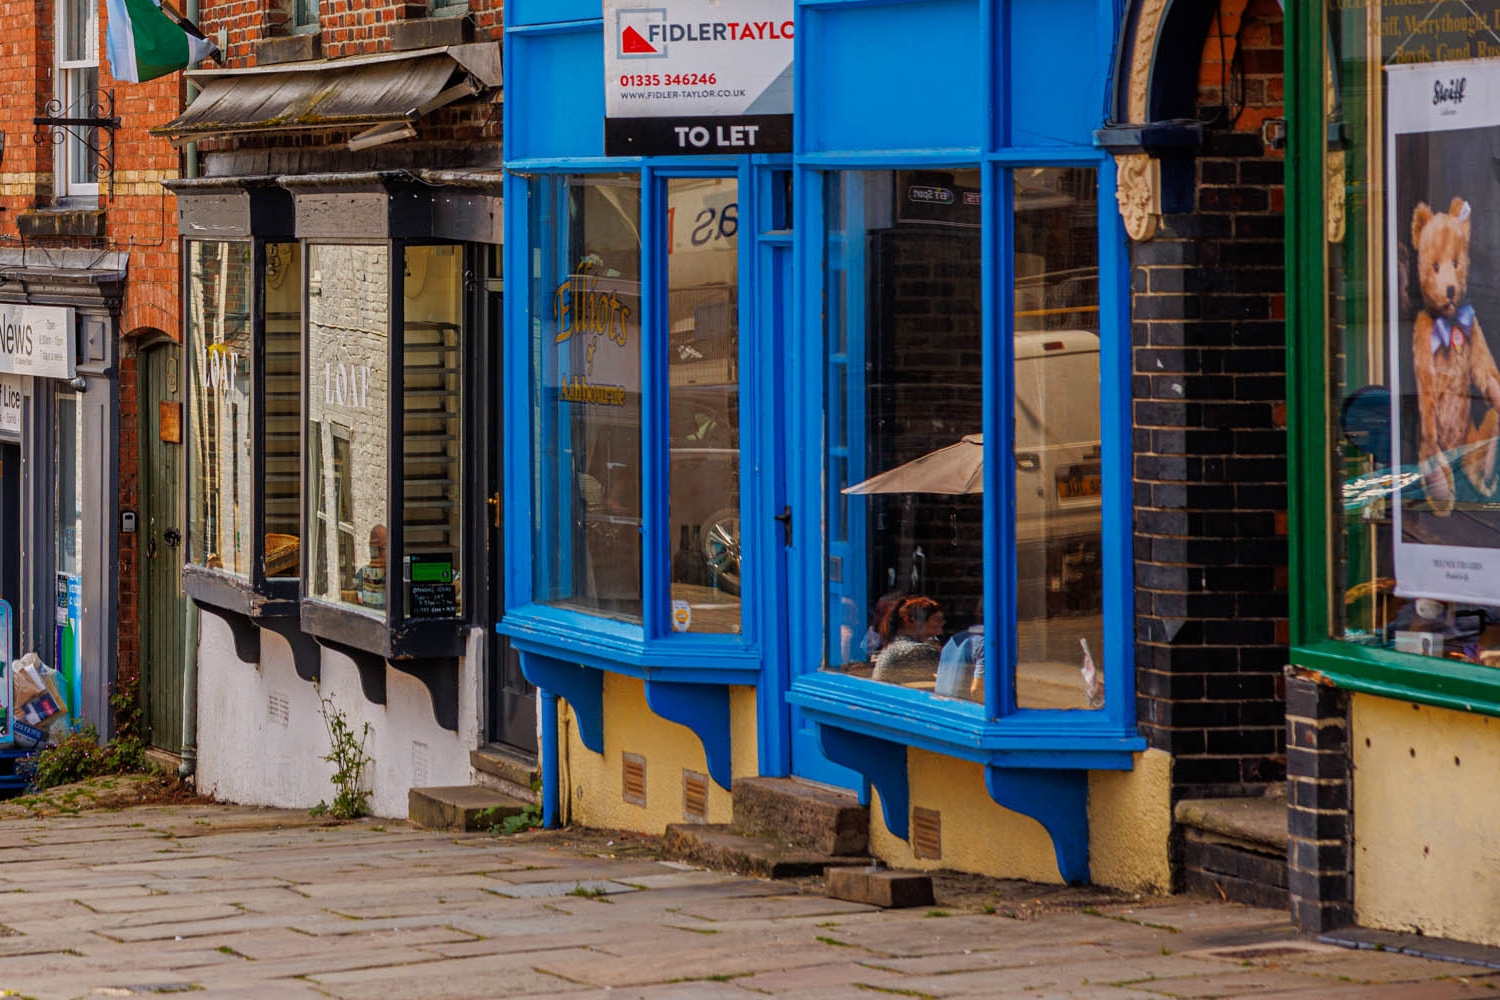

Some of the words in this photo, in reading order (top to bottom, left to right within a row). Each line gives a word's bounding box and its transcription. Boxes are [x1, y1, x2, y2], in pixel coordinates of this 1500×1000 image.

[649, 21, 794, 42] FIDLERTAYLO
[620, 74, 660, 87] 01335
[665, 73, 716, 85] 346246
[621, 89, 746, 100] WWW.FIDLER-TAYLOR.CO.UK
[675, 126, 710, 147] TO
[716, 126, 759, 146] LET
[553, 261, 631, 346] Elliots
[202, 347, 238, 391] LOAF
[325, 362, 371, 408] LOAF
[3, 385, 20, 408] Lice
